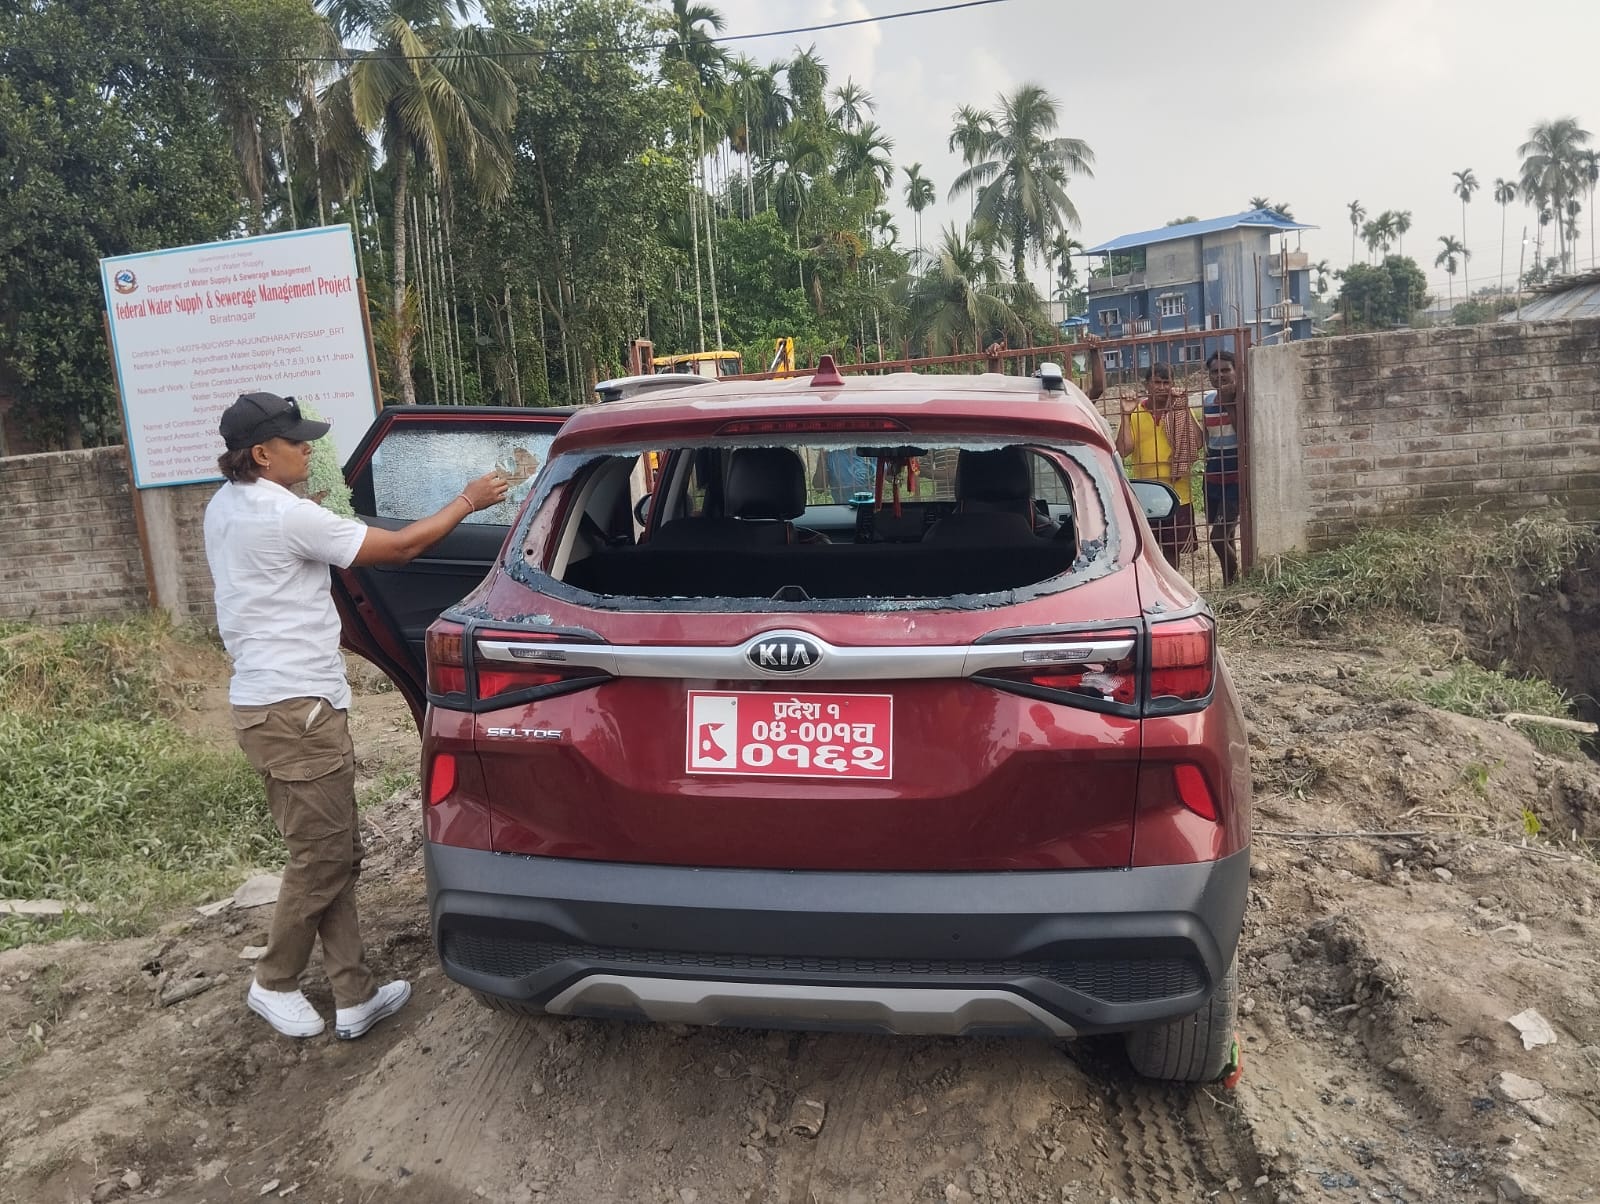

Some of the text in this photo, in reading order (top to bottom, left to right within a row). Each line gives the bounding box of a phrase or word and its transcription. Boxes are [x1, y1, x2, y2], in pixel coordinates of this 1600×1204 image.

[214, 263, 220, 271] of
[222, 262, 241, 270] Water
[241, 260, 264, 269] Supply
[147, 265, 312, 293] Department of Water Supply & Sewerage Management
[147, 298, 173, 316] Water
[175, 292, 204, 316] Supply
[206, 291, 213, 309] &
[215, 288, 257, 309] Sewerage
[258, 279, 317, 304] Management
[317, 275, 352, 298] Project
[209, 311, 256, 325] Biratnagar
[131, 349, 160, 359] Contract
[133, 363, 154, 371] Name
[154, 360, 161, 369] of
[191, 353, 229, 365] Arjundhara
[230, 351, 250, 360] Water
[251, 348, 275, 358] Supply
[194, 366, 230, 377] Arjundhara
[332, 352, 355, 361] Jhapa
[137, 387, 157, 395] Name
[158, 384, 165, 393] of
[190, 380, 210, 390] Entire
[210, 376, 255, 387] Construction
[254, 373, 273, 382] Work
[274, 371, 282, 380] of
[282, 369, 321, 380] Arjundhara
[191, 391, 211, 401] Water
[211, 390, 236, 400] Supply
[314, 393, 320, 401] &
[322, 392, 330, 400] 11
[331, 391, 355, 400] Jhapa
[143, 423, 163, 431] Name
[163, 421, 171, 429] of
[145, 434, 173, 443] Contract
[147, 447, 163, 456] Date
[163, 446, 171, 454] of
[149, 459, 165, 467] Date
[166, 457, 173, 466] of
[174, 456, 192, 465] Work
[151, 471, 167, 479] Date
[167, 469, 175, 478] of
[175, 468, 194, 477] Work
[759, 643, 811, 666] KIA
[773, 697, 840, 720] प्रदेश १
[486, 727, 563, 740] SELTOS
